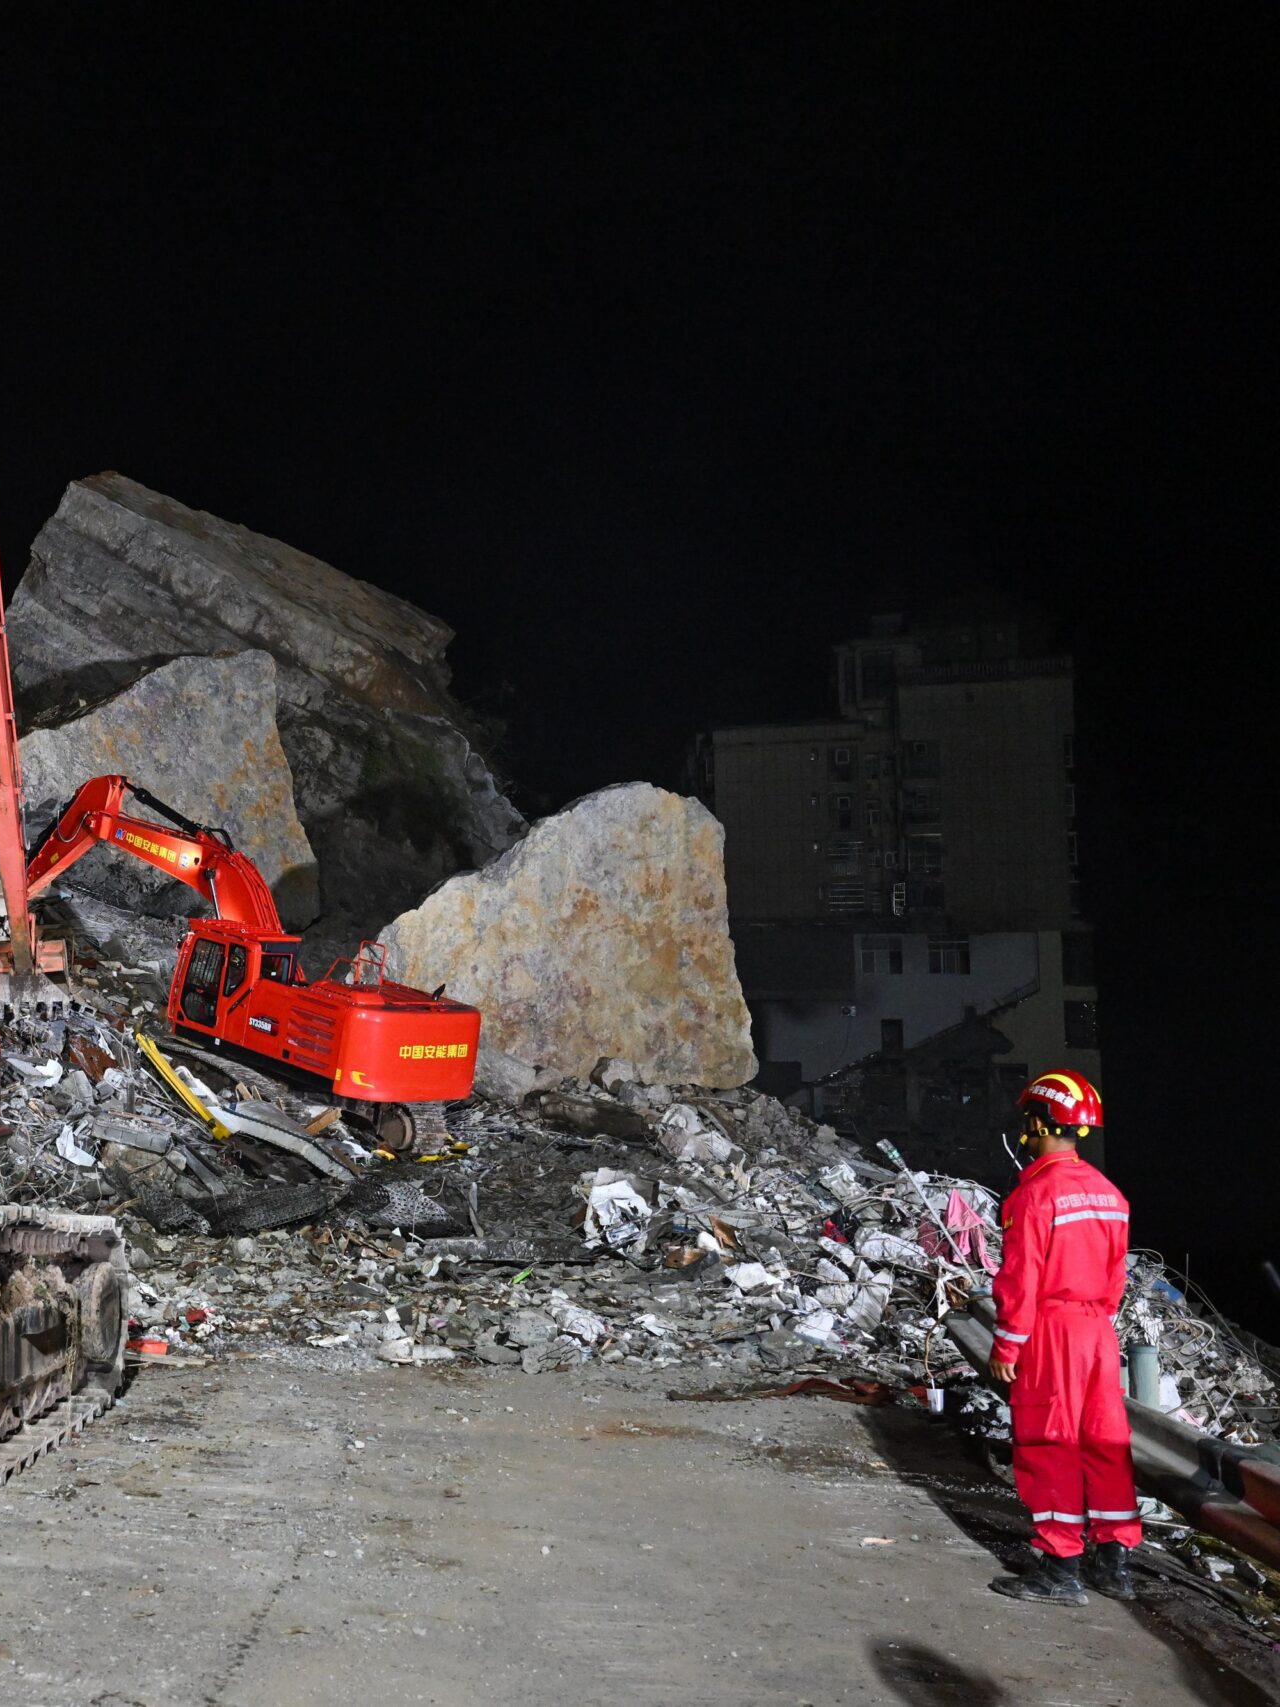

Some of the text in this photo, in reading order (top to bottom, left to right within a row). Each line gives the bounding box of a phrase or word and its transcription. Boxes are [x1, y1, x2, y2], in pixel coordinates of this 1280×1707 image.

[125, 832, 177, 863] 中国安能集团
[399, 1044, 468, 1059] 中国安能集团
